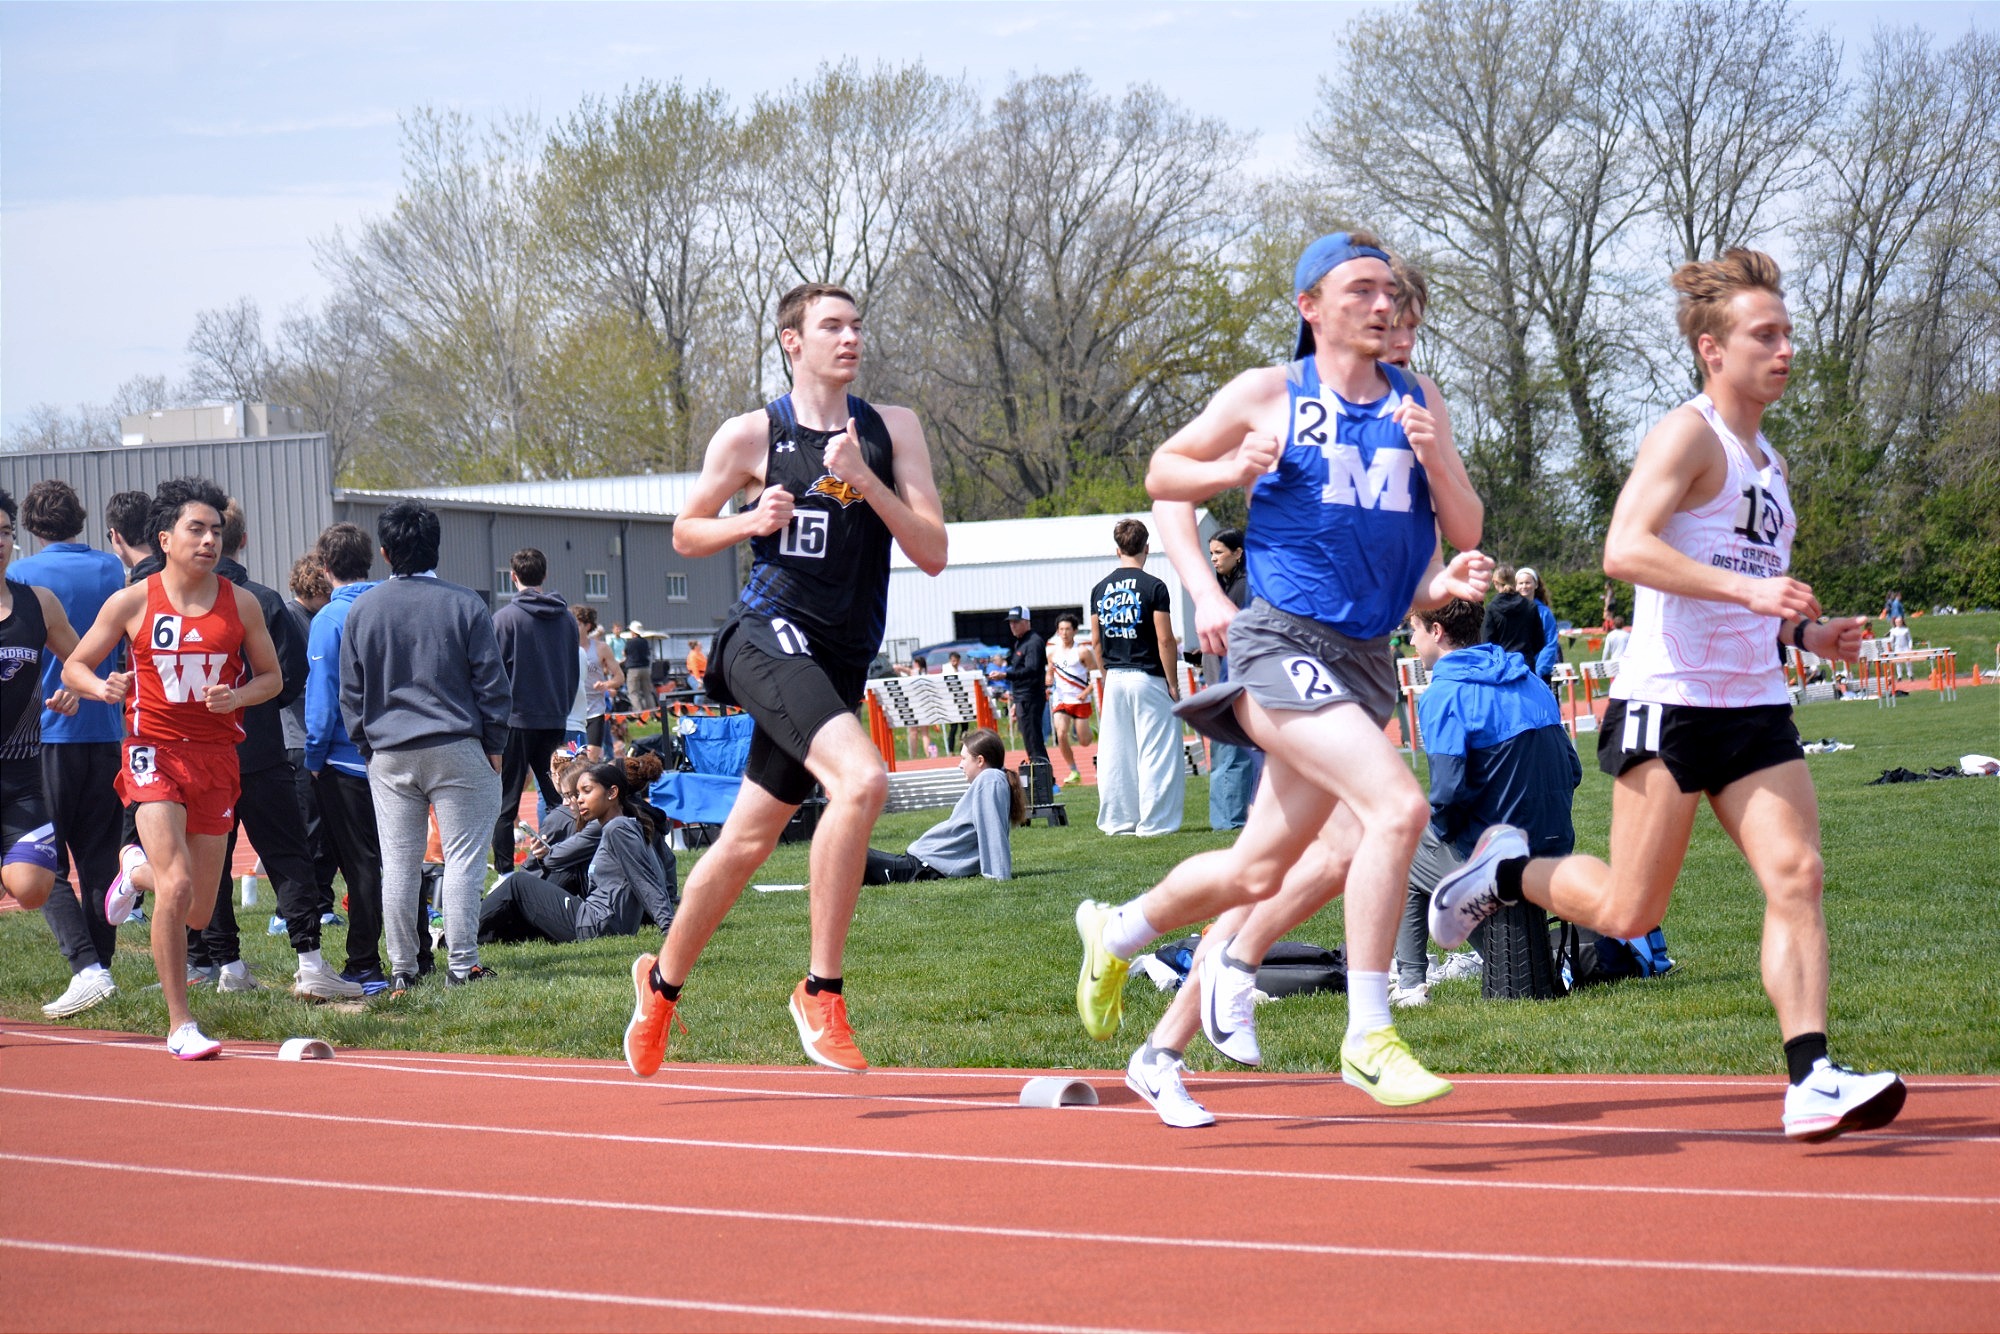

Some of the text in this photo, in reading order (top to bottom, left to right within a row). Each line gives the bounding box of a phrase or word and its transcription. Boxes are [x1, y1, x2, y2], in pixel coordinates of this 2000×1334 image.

[1298, 401, 1328, 444] 2
[1320, 443, 1415, 512] M
[786, 516, 825, 555] 15
[1712, 553, 1766, 578] DISTANCE
[1104, 579, 1137, 595] ANTI
[153, 615, 174, 648] 6
[1104, 627, 1138, 639] CLUB
[151, 653, 229, 703] W
[1290, 660, 1333, 700] 2
[131, 746, 149, 774] 6
